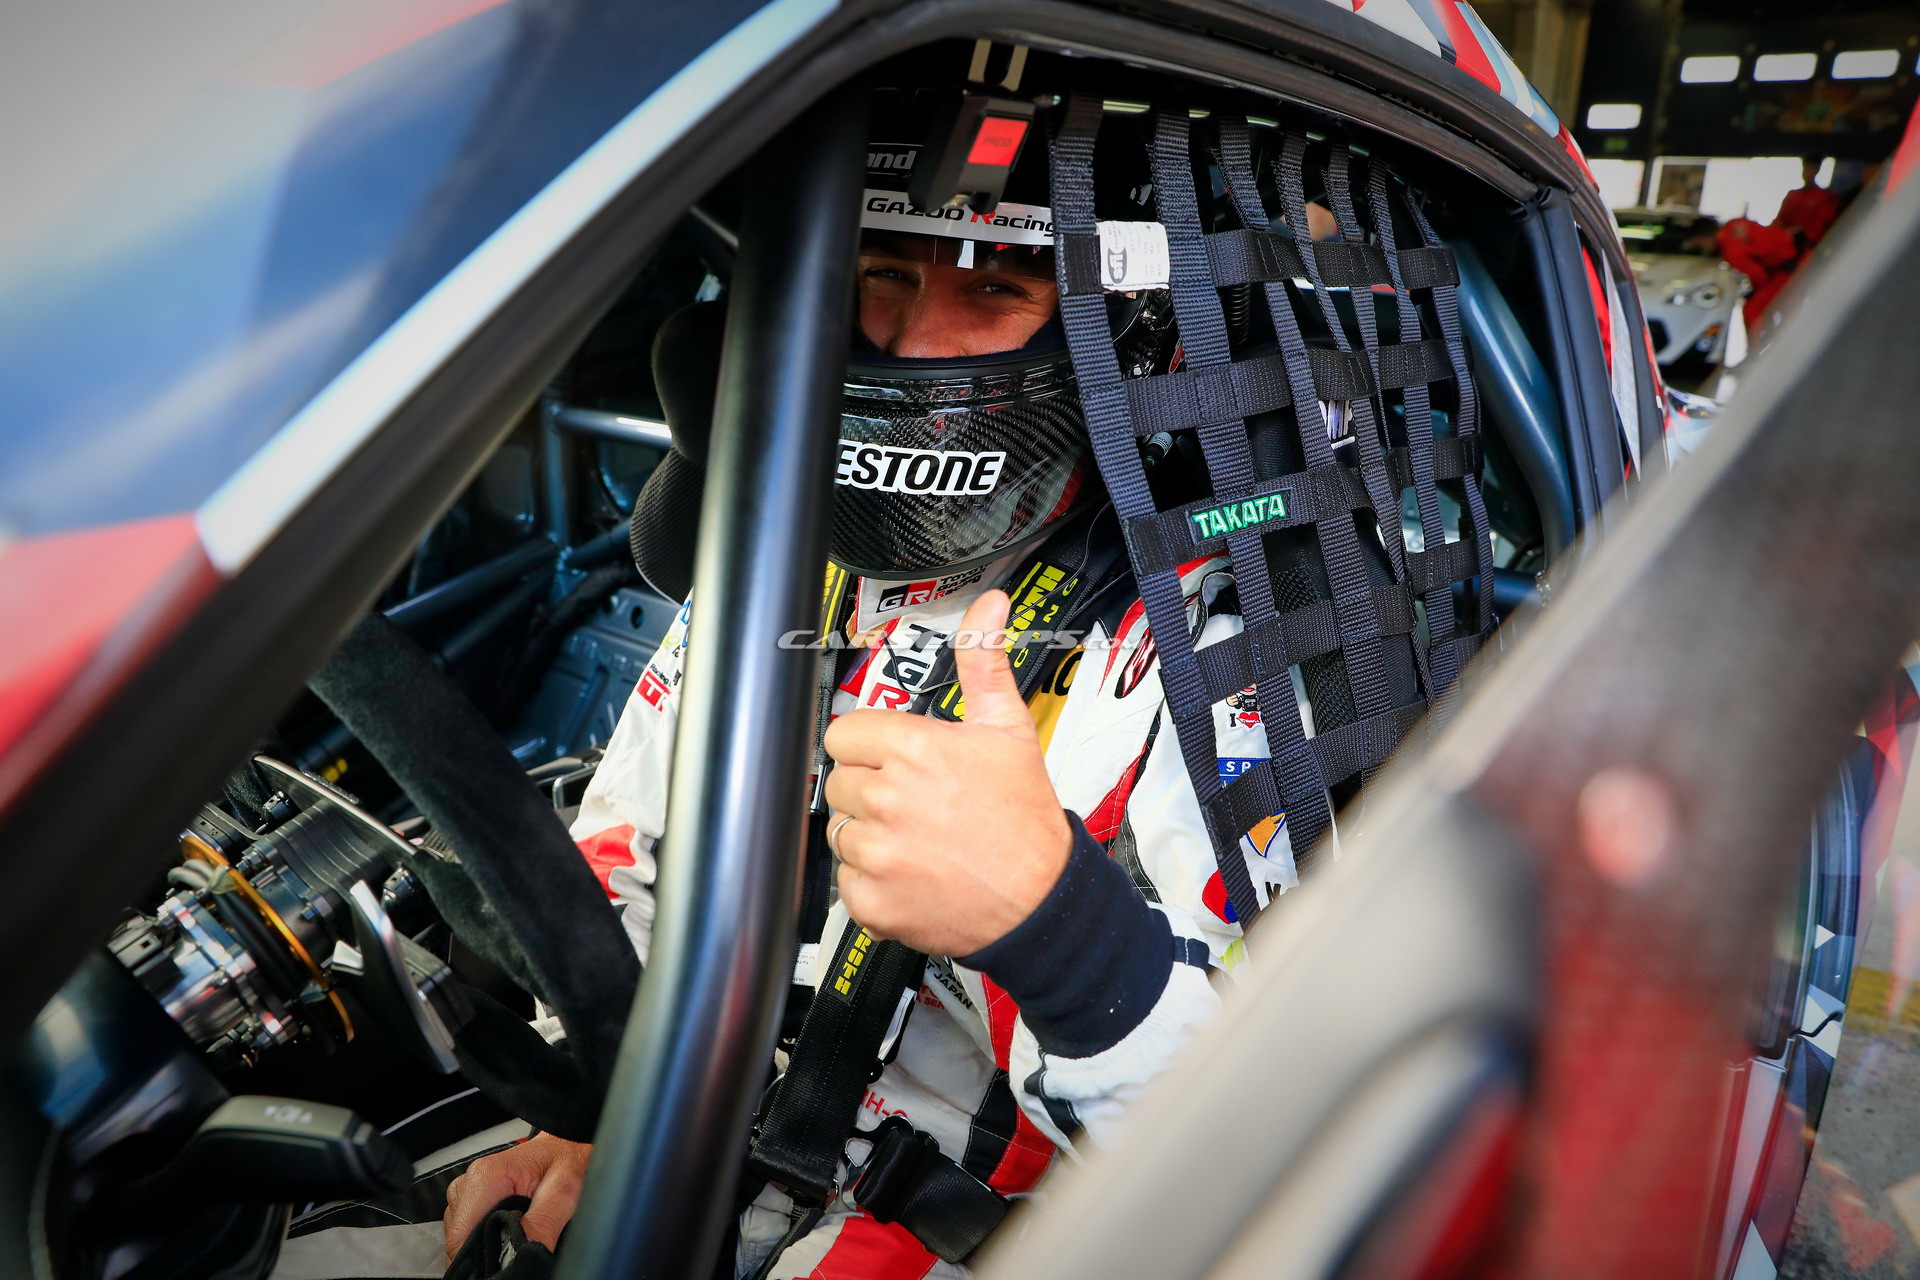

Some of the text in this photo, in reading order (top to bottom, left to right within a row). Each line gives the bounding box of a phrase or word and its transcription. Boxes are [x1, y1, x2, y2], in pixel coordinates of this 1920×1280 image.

[866, 197, 1055, 237] GAZOO Racing
[835, 442, 1001, 491] ESTONE
[1192, 494, 1287, 538] TAKATA
[878, 588, 932, 612] GR
[834, 927, 872, 996] ROTH
[934, 972, 973, 1010] JAPAN
